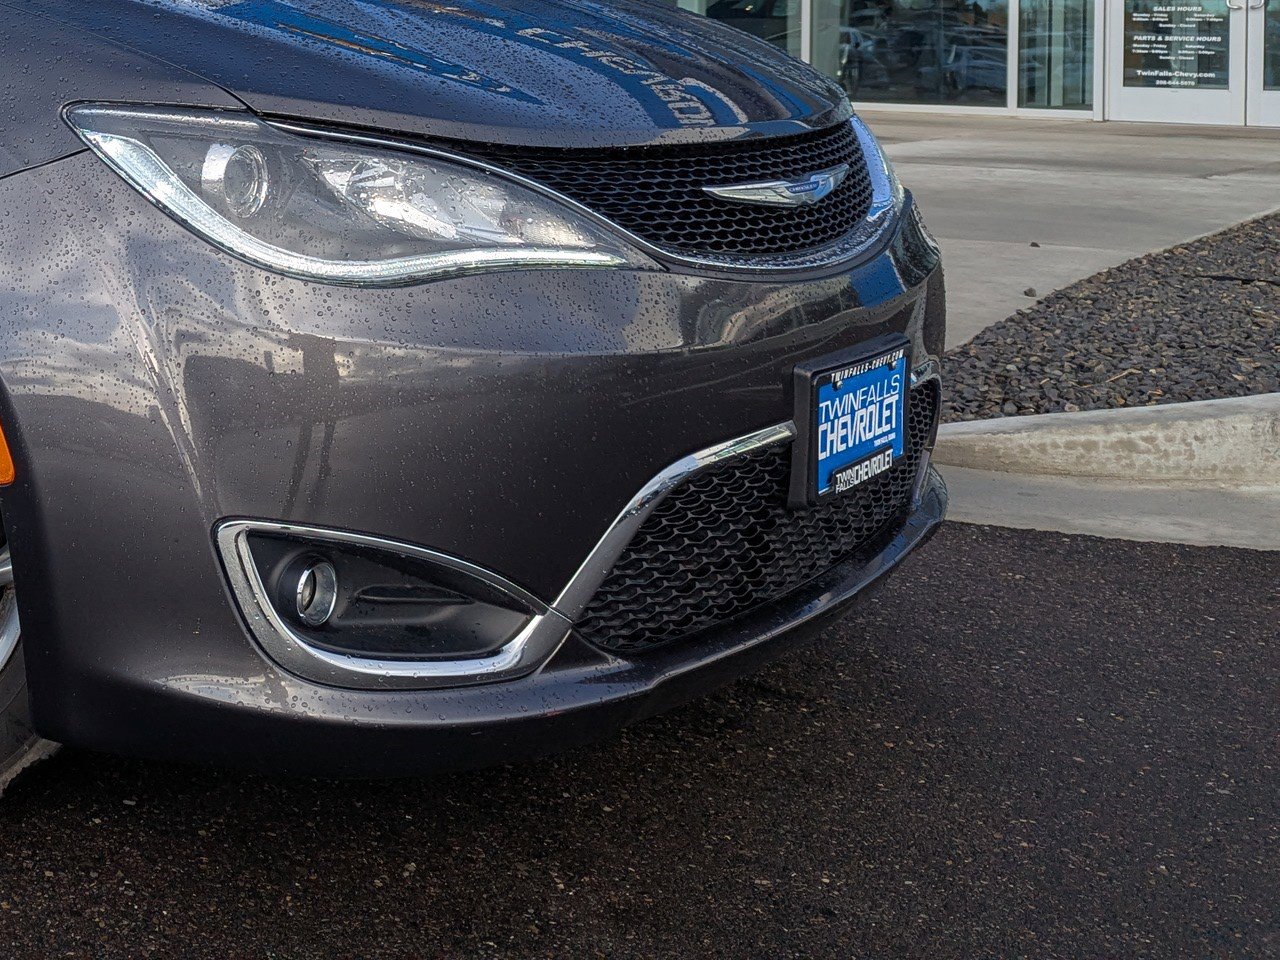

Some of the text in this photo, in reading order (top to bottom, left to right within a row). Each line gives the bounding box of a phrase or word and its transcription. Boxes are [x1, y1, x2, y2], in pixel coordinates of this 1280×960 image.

[819, 374, 900, 423] TWINFALLS
[818, 393, 899, 461] CHEVROLET
[835, 448, 894, 486] TWIN CHEVROLET
[835, 477, 856, 494] FALLS
